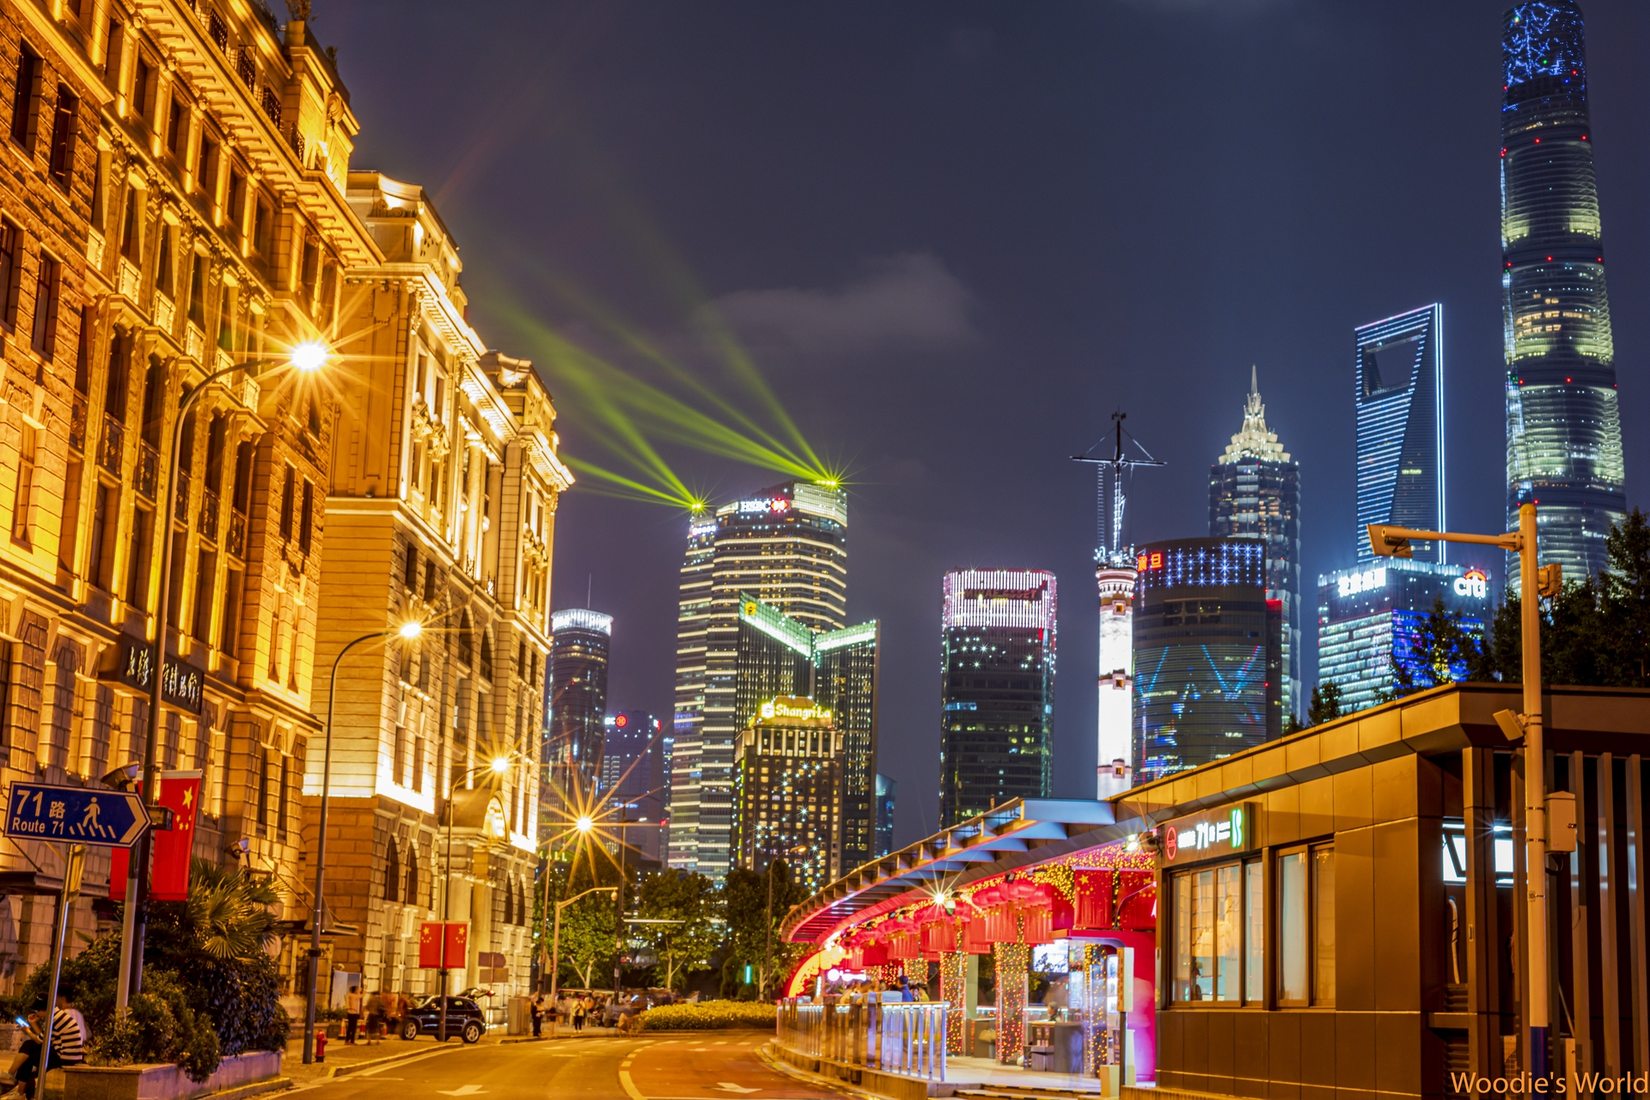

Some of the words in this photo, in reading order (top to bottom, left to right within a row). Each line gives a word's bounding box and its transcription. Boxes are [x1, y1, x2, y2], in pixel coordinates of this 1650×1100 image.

[1454, 576, 1486, 598] citi
[16, 789, 44, 817] 71
[49, 801, 66, 819] 路
[12, 817, 46, 834] Route
[52, 821, 65, 835] 71
